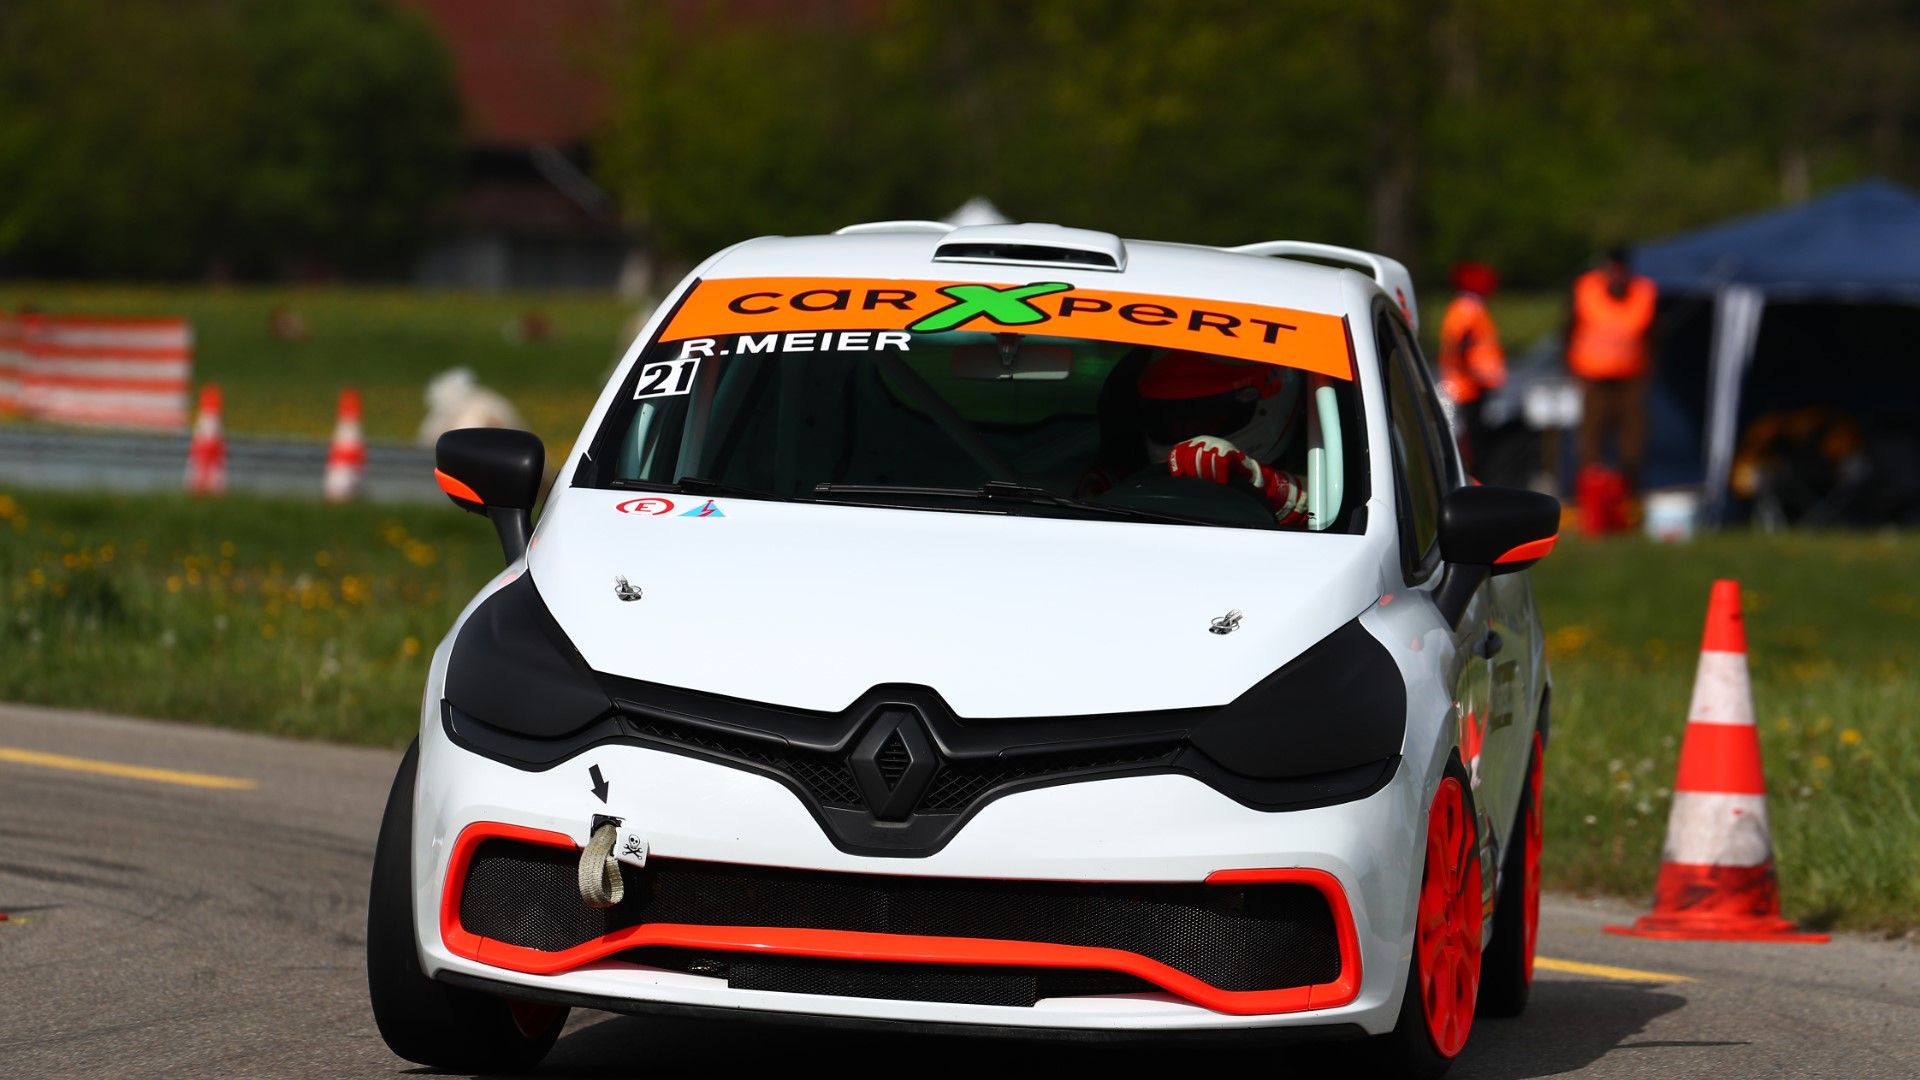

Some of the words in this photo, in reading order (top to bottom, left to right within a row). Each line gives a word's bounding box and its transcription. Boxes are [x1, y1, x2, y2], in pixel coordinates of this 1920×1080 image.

[680, 331, 911, 359] R.MEIER
[638, 361, 692, 396] 21
[635, 502, 656, 512] E
